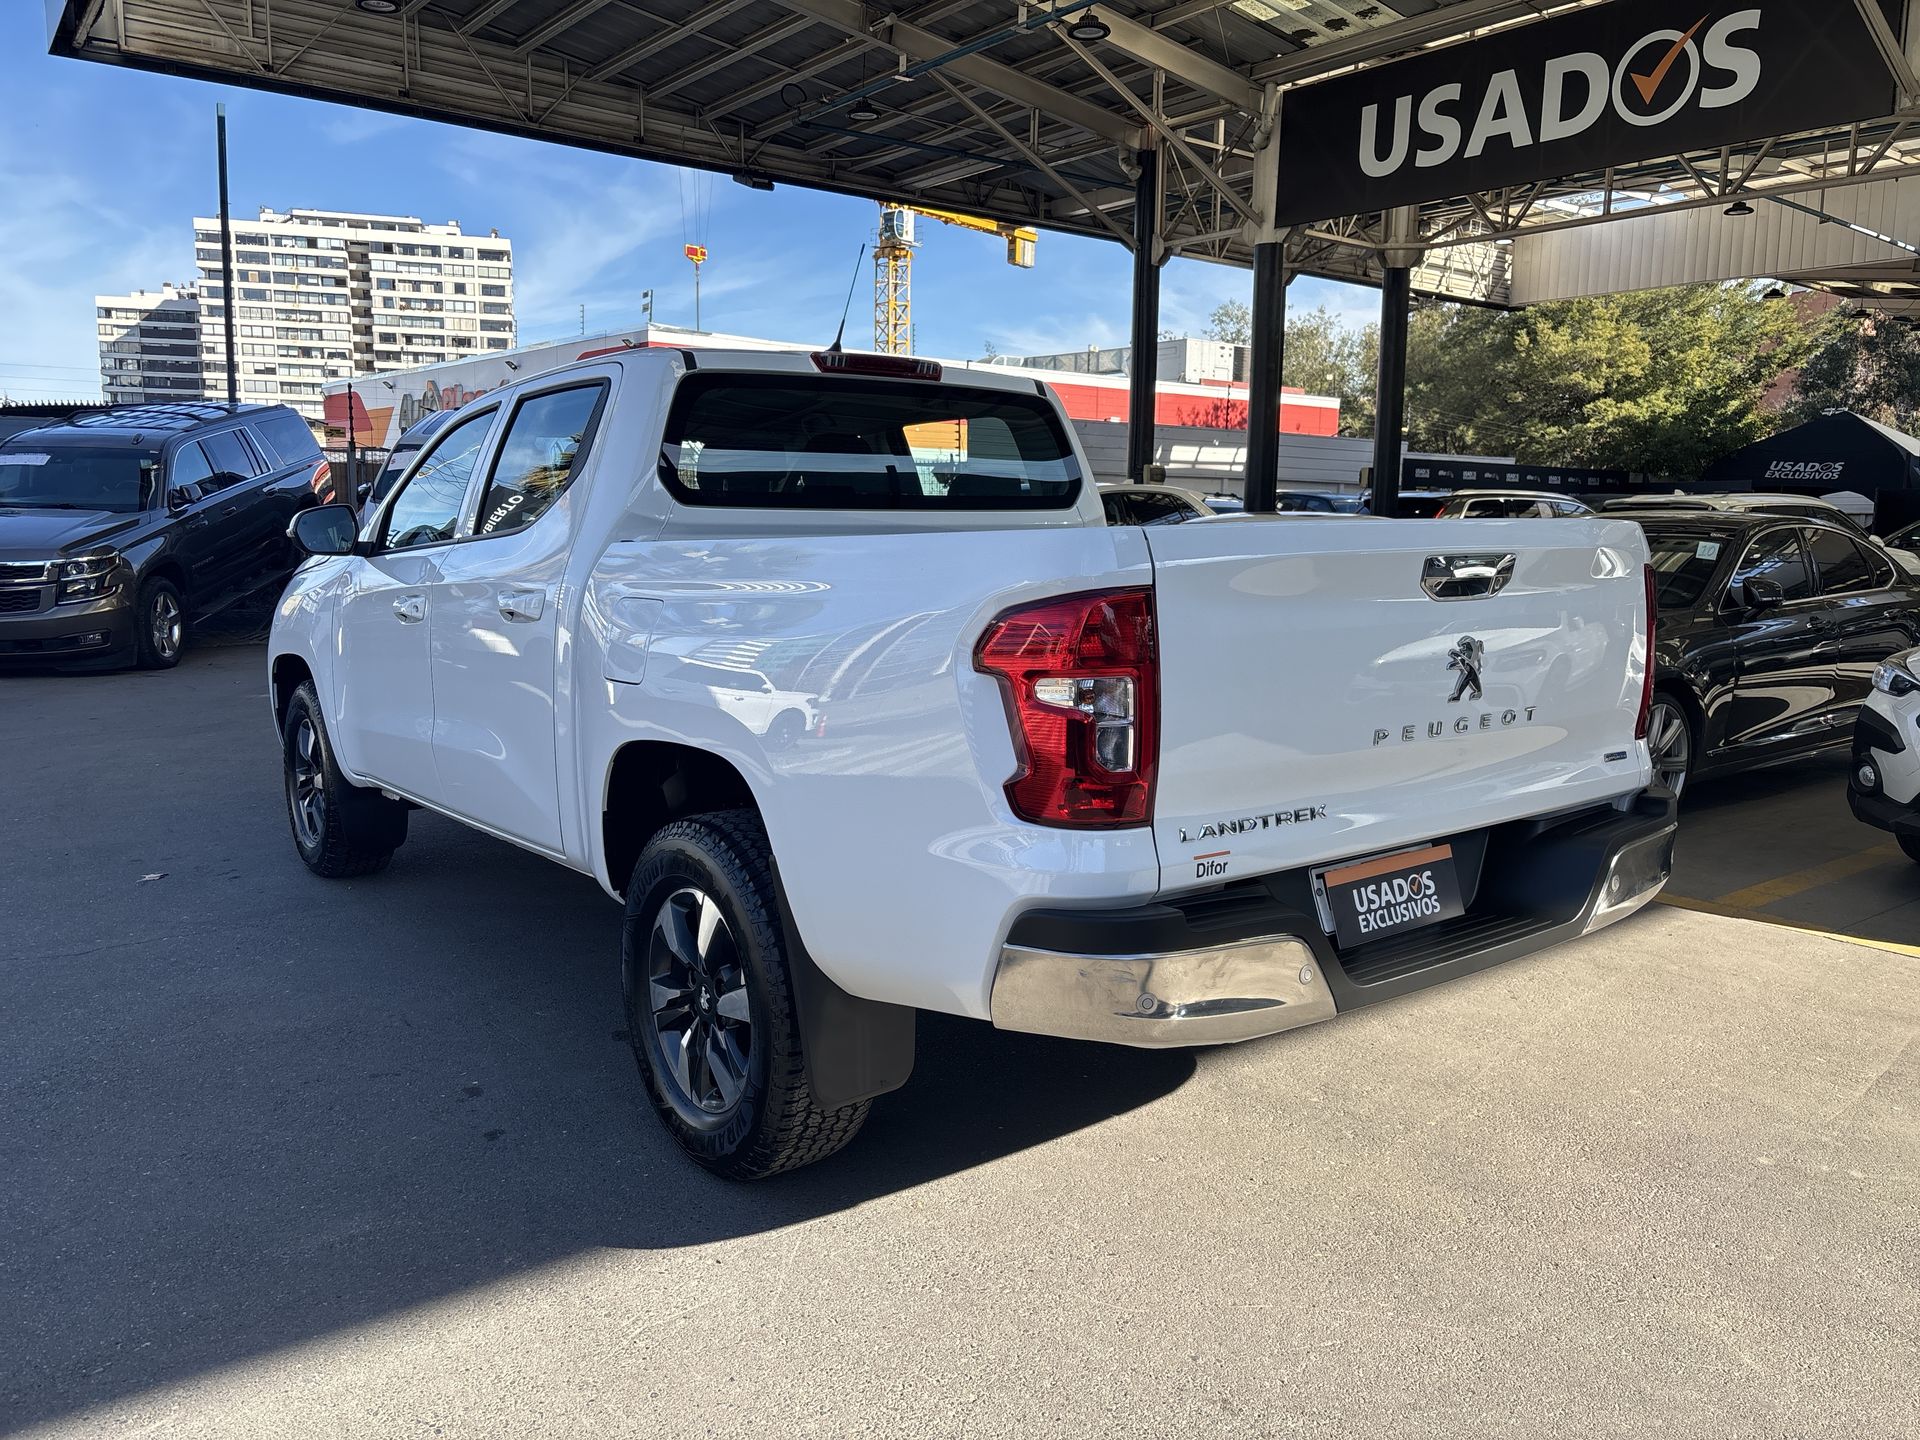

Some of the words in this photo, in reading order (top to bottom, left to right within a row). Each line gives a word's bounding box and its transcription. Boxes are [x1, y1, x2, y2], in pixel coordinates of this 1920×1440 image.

[1359, 9, 1762, 178] USADOS
[1764, 470, 1841, 480] EXCLUSIVOS
[1769, 460, 1845, 472] USADOS
[1372, 705, 1537, 746] PEUGEOT
[1178, 803, 1328, 844] LANDTREK
[1195, 860, 1229, 879] Difor
[1352, 870, 1436, 913] USADOS
[1358, 894, 1441, 934] EXCLUSIVOS
